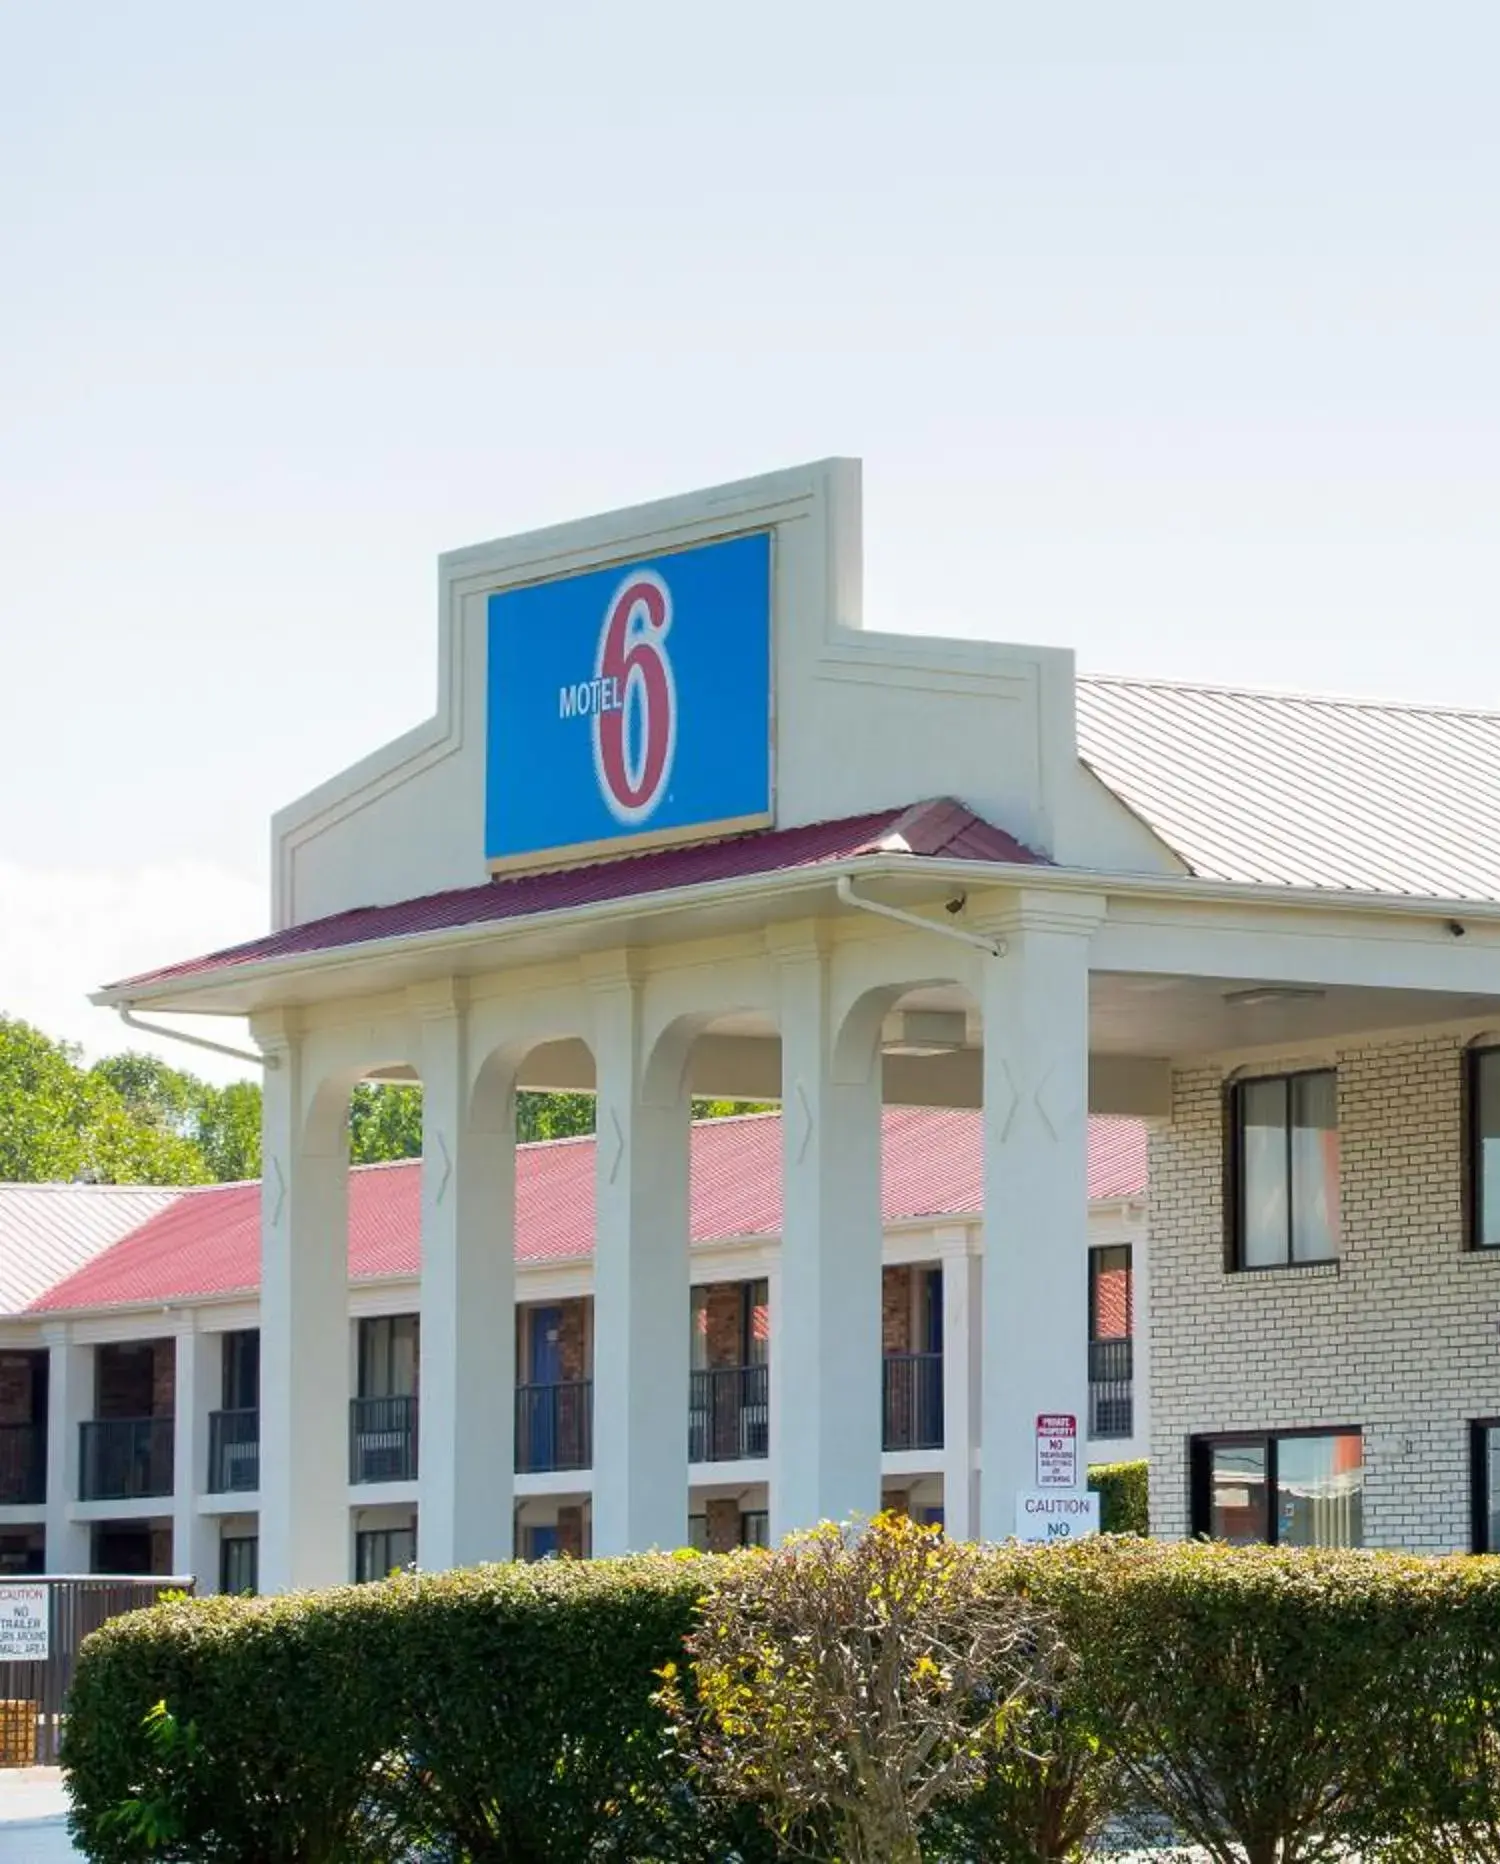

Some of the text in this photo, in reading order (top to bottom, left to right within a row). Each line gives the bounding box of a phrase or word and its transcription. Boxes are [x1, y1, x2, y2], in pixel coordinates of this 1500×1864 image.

[559, 573, 674, 820] MOTEL 6
[1049, 1439, 1063, 1450] NO
[1025, 1499, 1090, 1513] CAUTION
[1047, 1522, 1071, 1537] NO
[13, 1606, 29, 1617] NO
[1, 1619, 41, 1629] TRAILER
